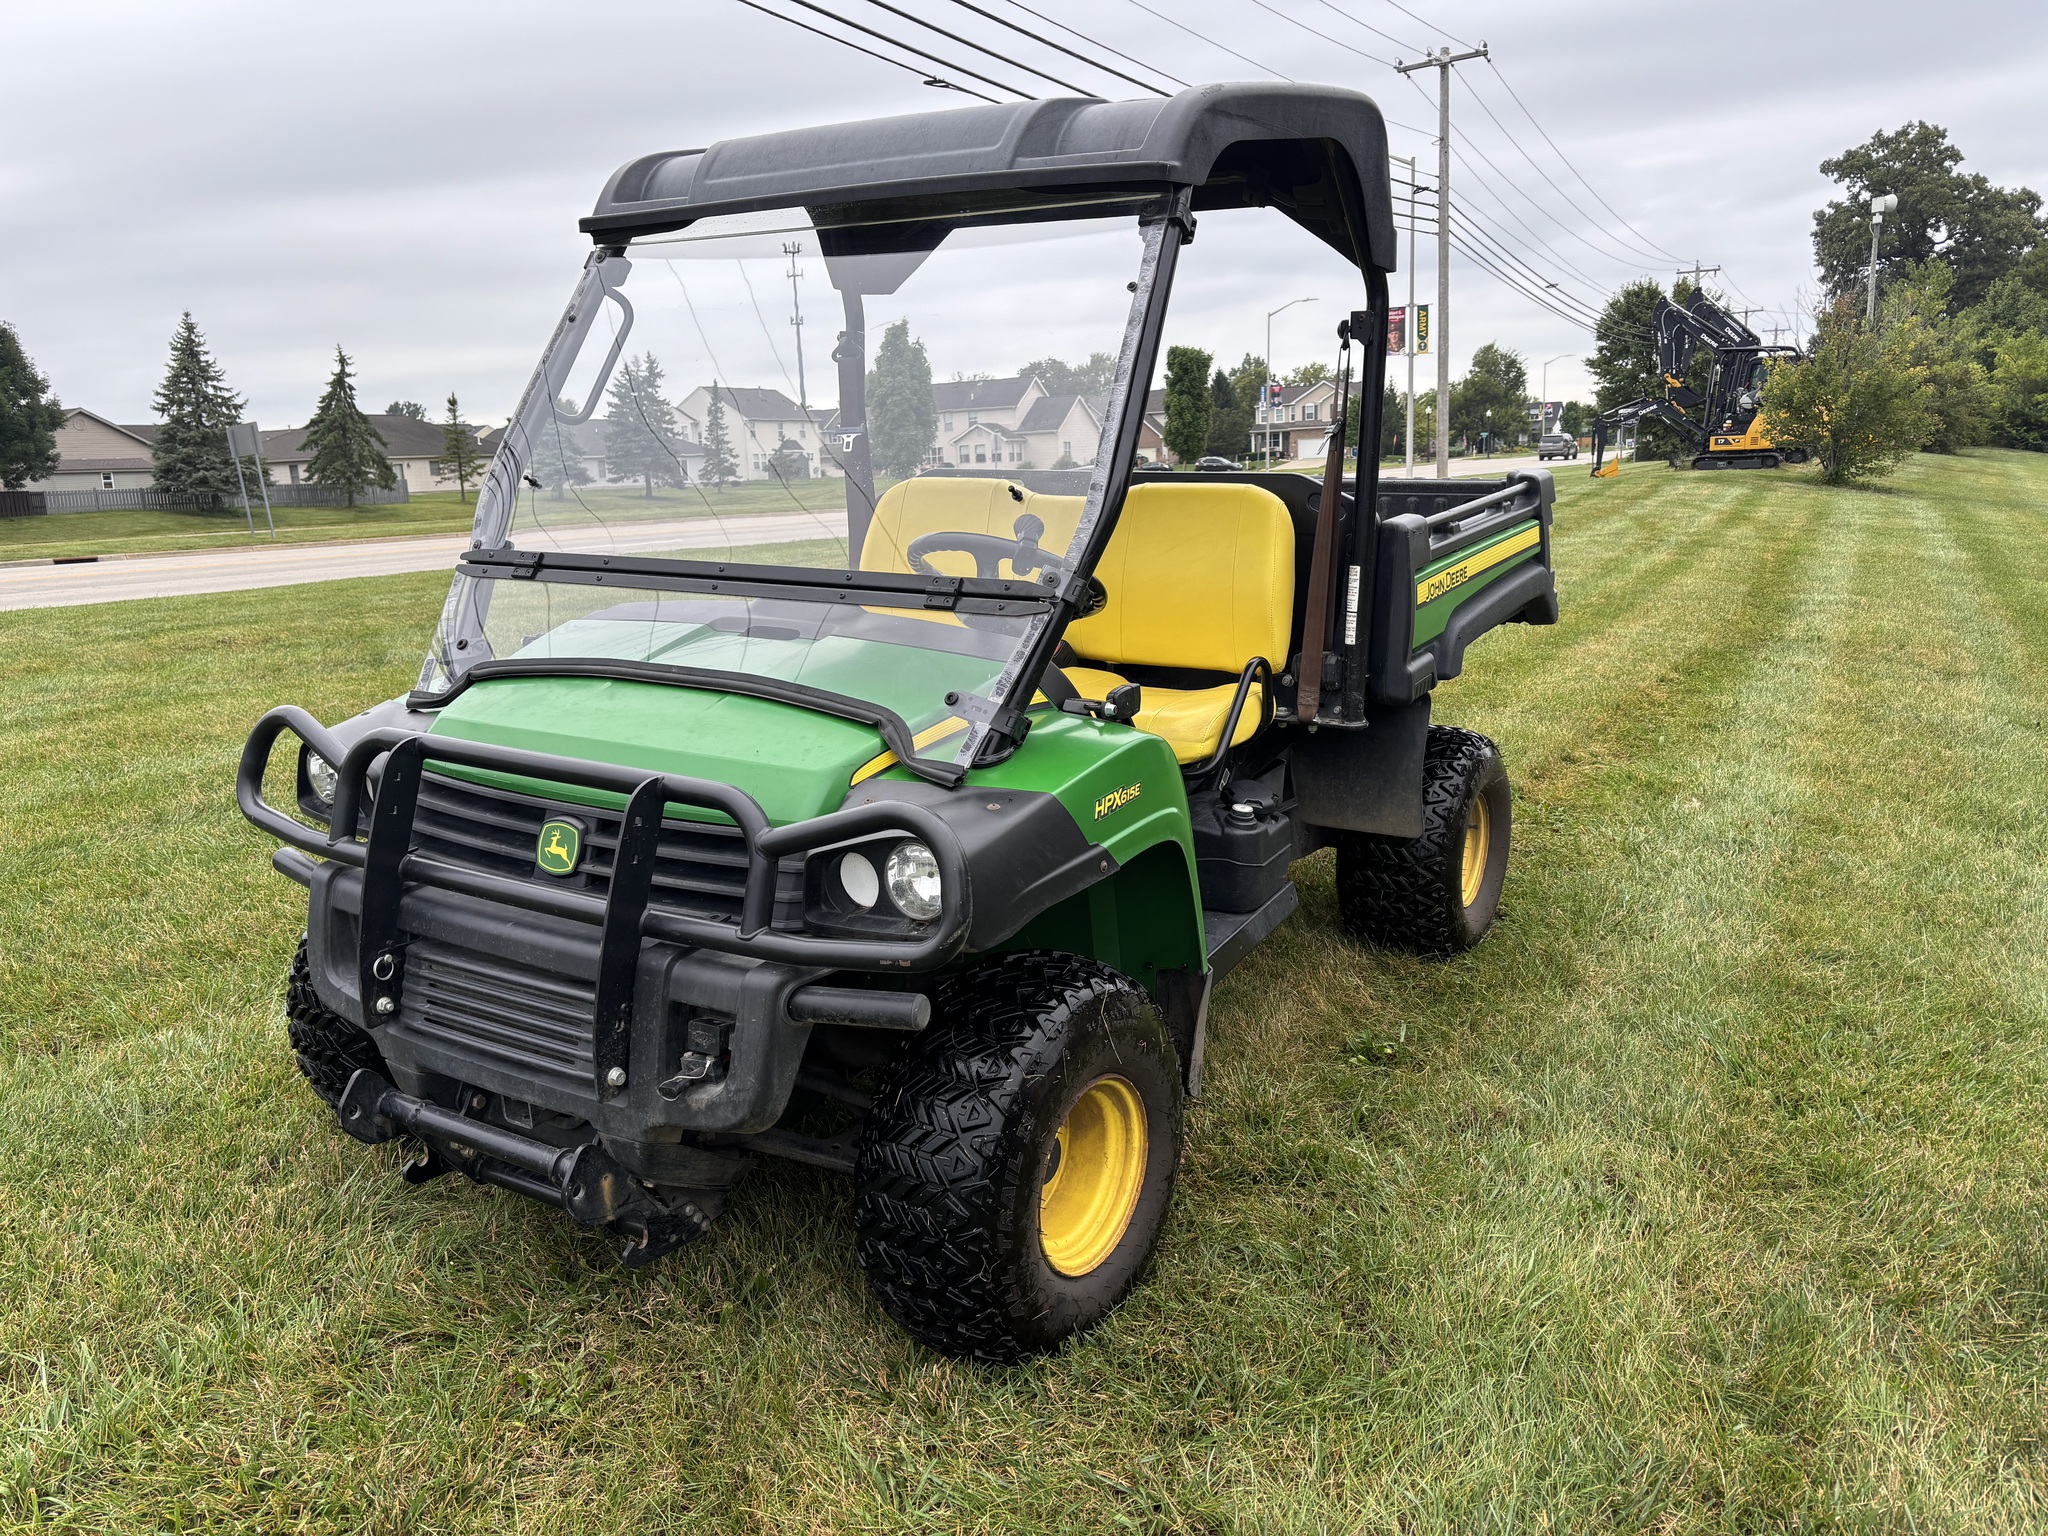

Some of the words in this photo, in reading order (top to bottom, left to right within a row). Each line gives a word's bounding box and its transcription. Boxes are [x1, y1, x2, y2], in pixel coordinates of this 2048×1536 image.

[1419, 310, 1427, 337] ARMY
[1724, 326, 1741, 343] DEERE
[1700, 333, 1719, 348] DEERE
[1638, 404, 1658, 416] DEERE
[1426, 579, 1445, 600] JOHN
[1446, 566, 1468, 589] DEERE
[1094, 782, 1141, 821] HPX615E
[998, 1151, 1024, 1255] TRAIL
